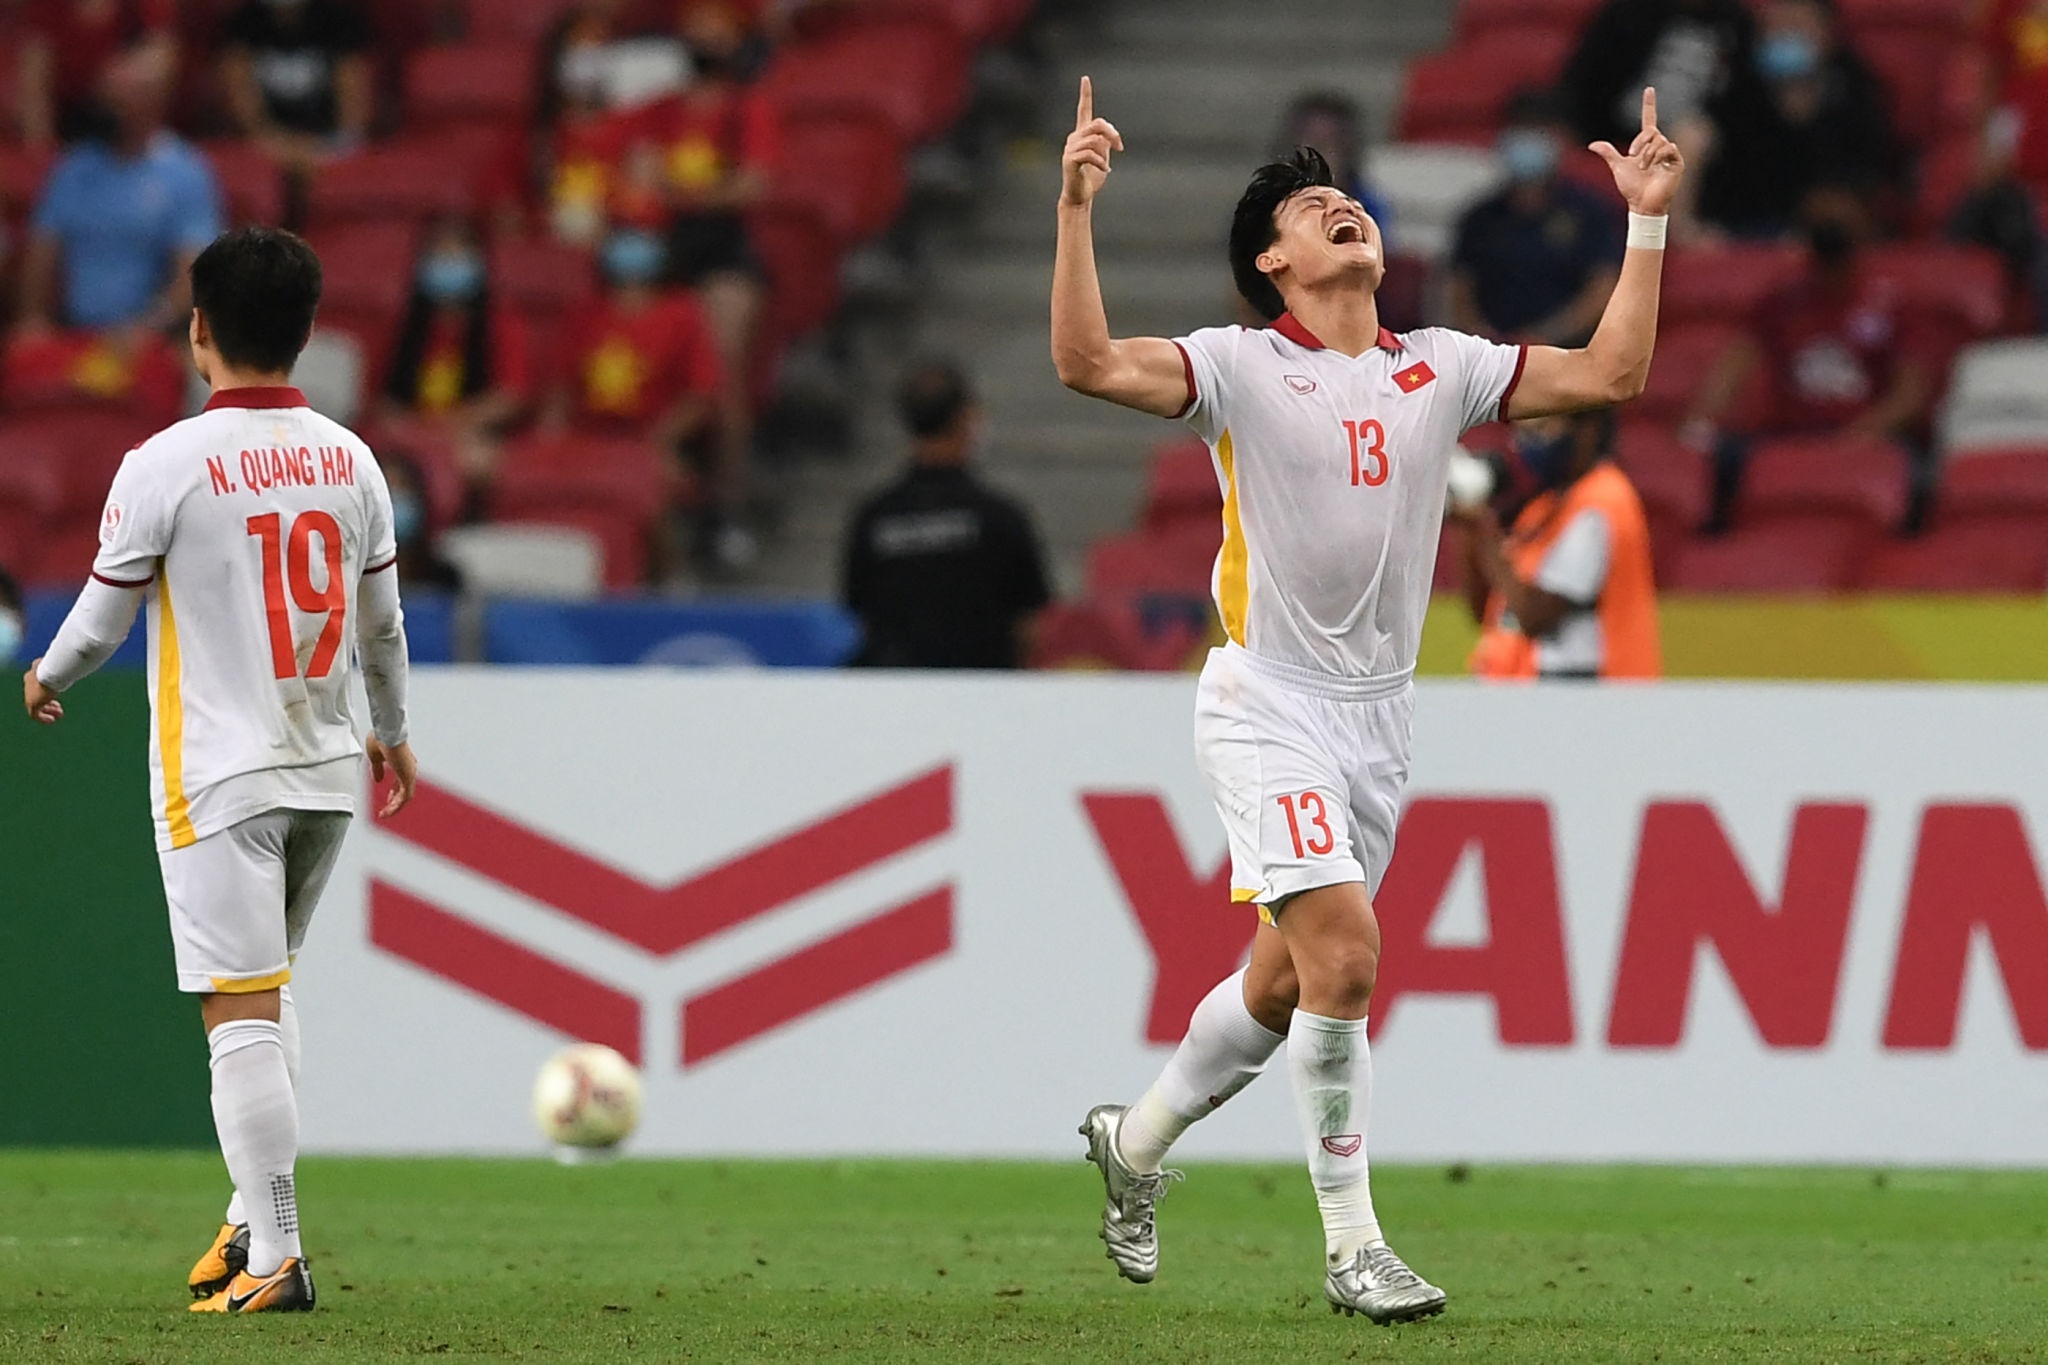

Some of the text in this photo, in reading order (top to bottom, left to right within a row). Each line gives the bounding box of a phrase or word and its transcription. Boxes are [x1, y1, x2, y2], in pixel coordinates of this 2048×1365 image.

[206, 446, 355, 496] N. QUANG HAI
[1343, 419, 1389, 486] 13
[246, 510, 346, 679] 19
[1277, 791, 1334, 859] 13
